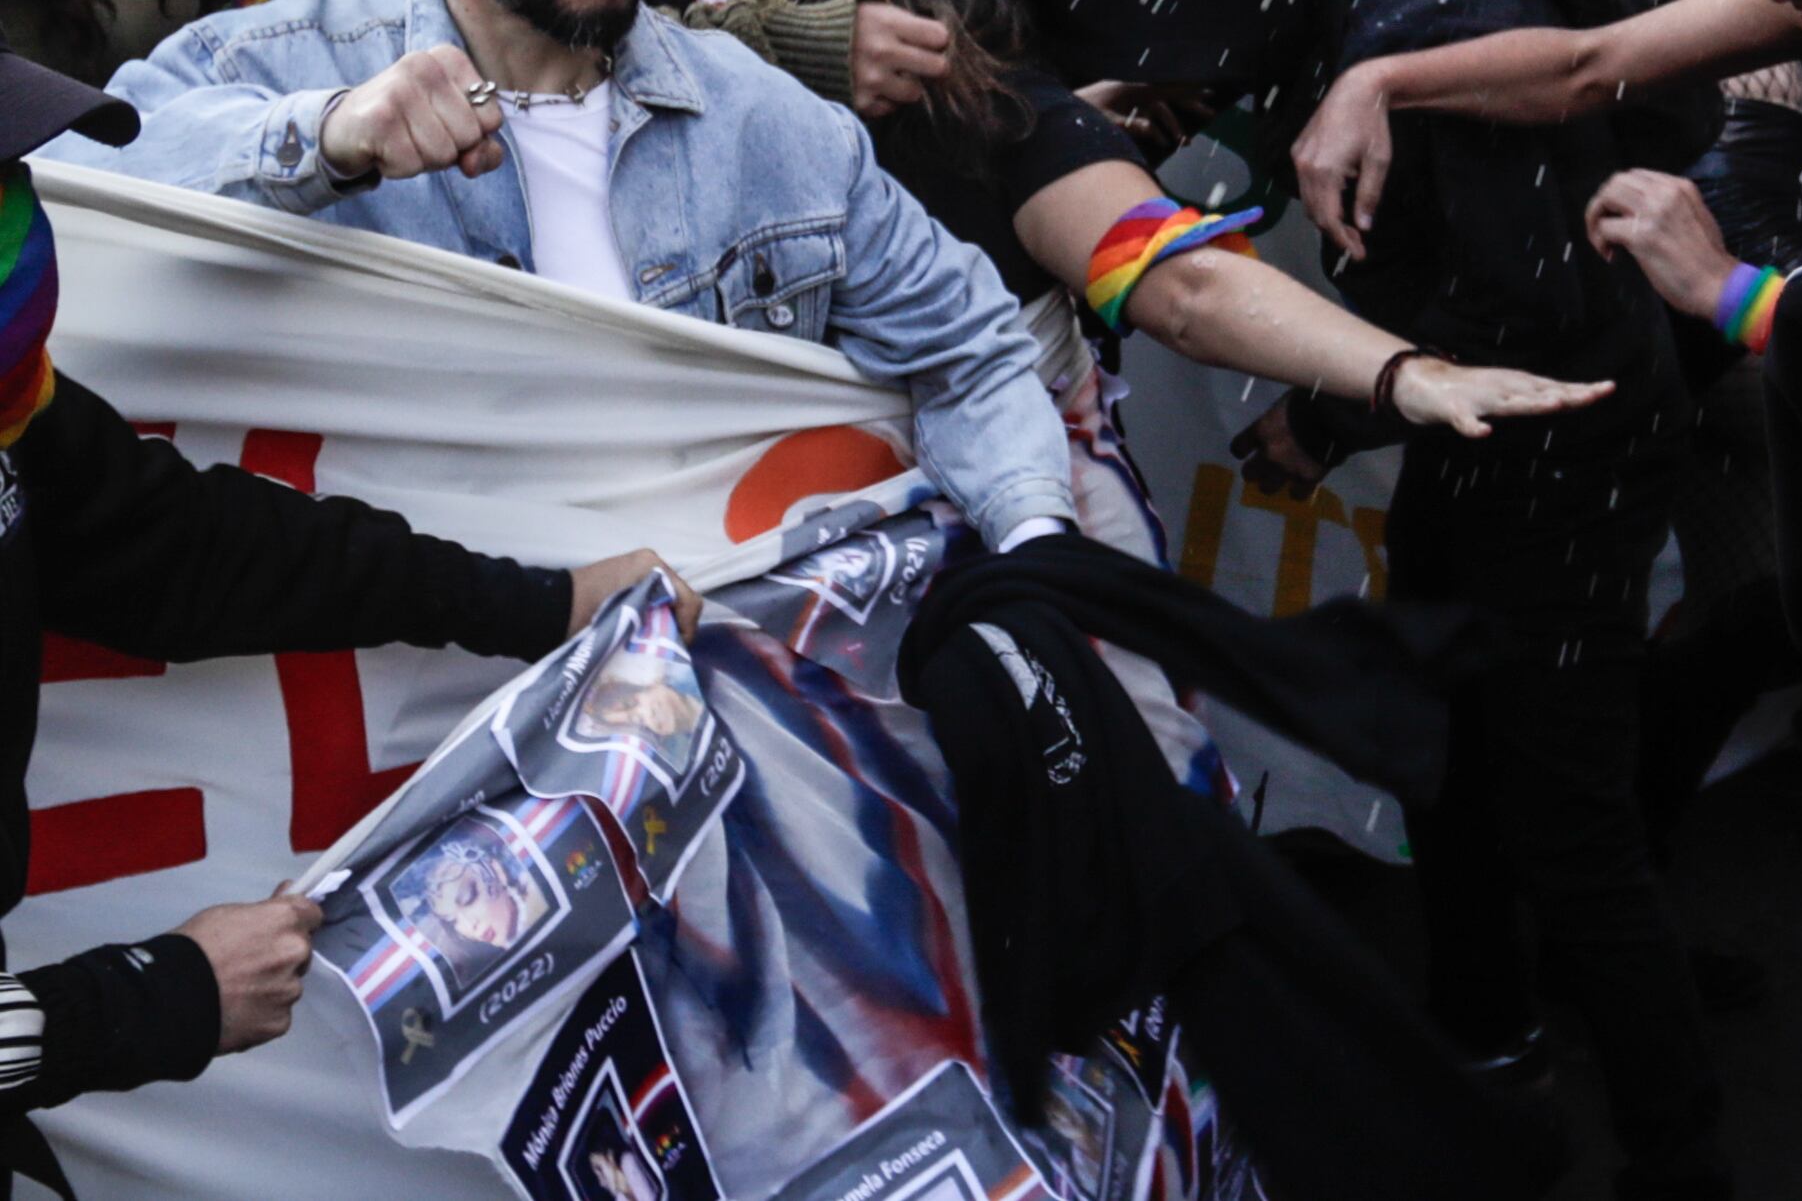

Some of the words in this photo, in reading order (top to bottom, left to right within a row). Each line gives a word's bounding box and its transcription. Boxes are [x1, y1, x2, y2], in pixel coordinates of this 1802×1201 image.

[701, 737, 732, 797] (202
[479, 953, 555, 1024] (2022)
[552, 1044, 590, 1111] Briones
[584, 995, 628, 1051] Puccio
[878, 1130, 947, 1181] Fonseca
